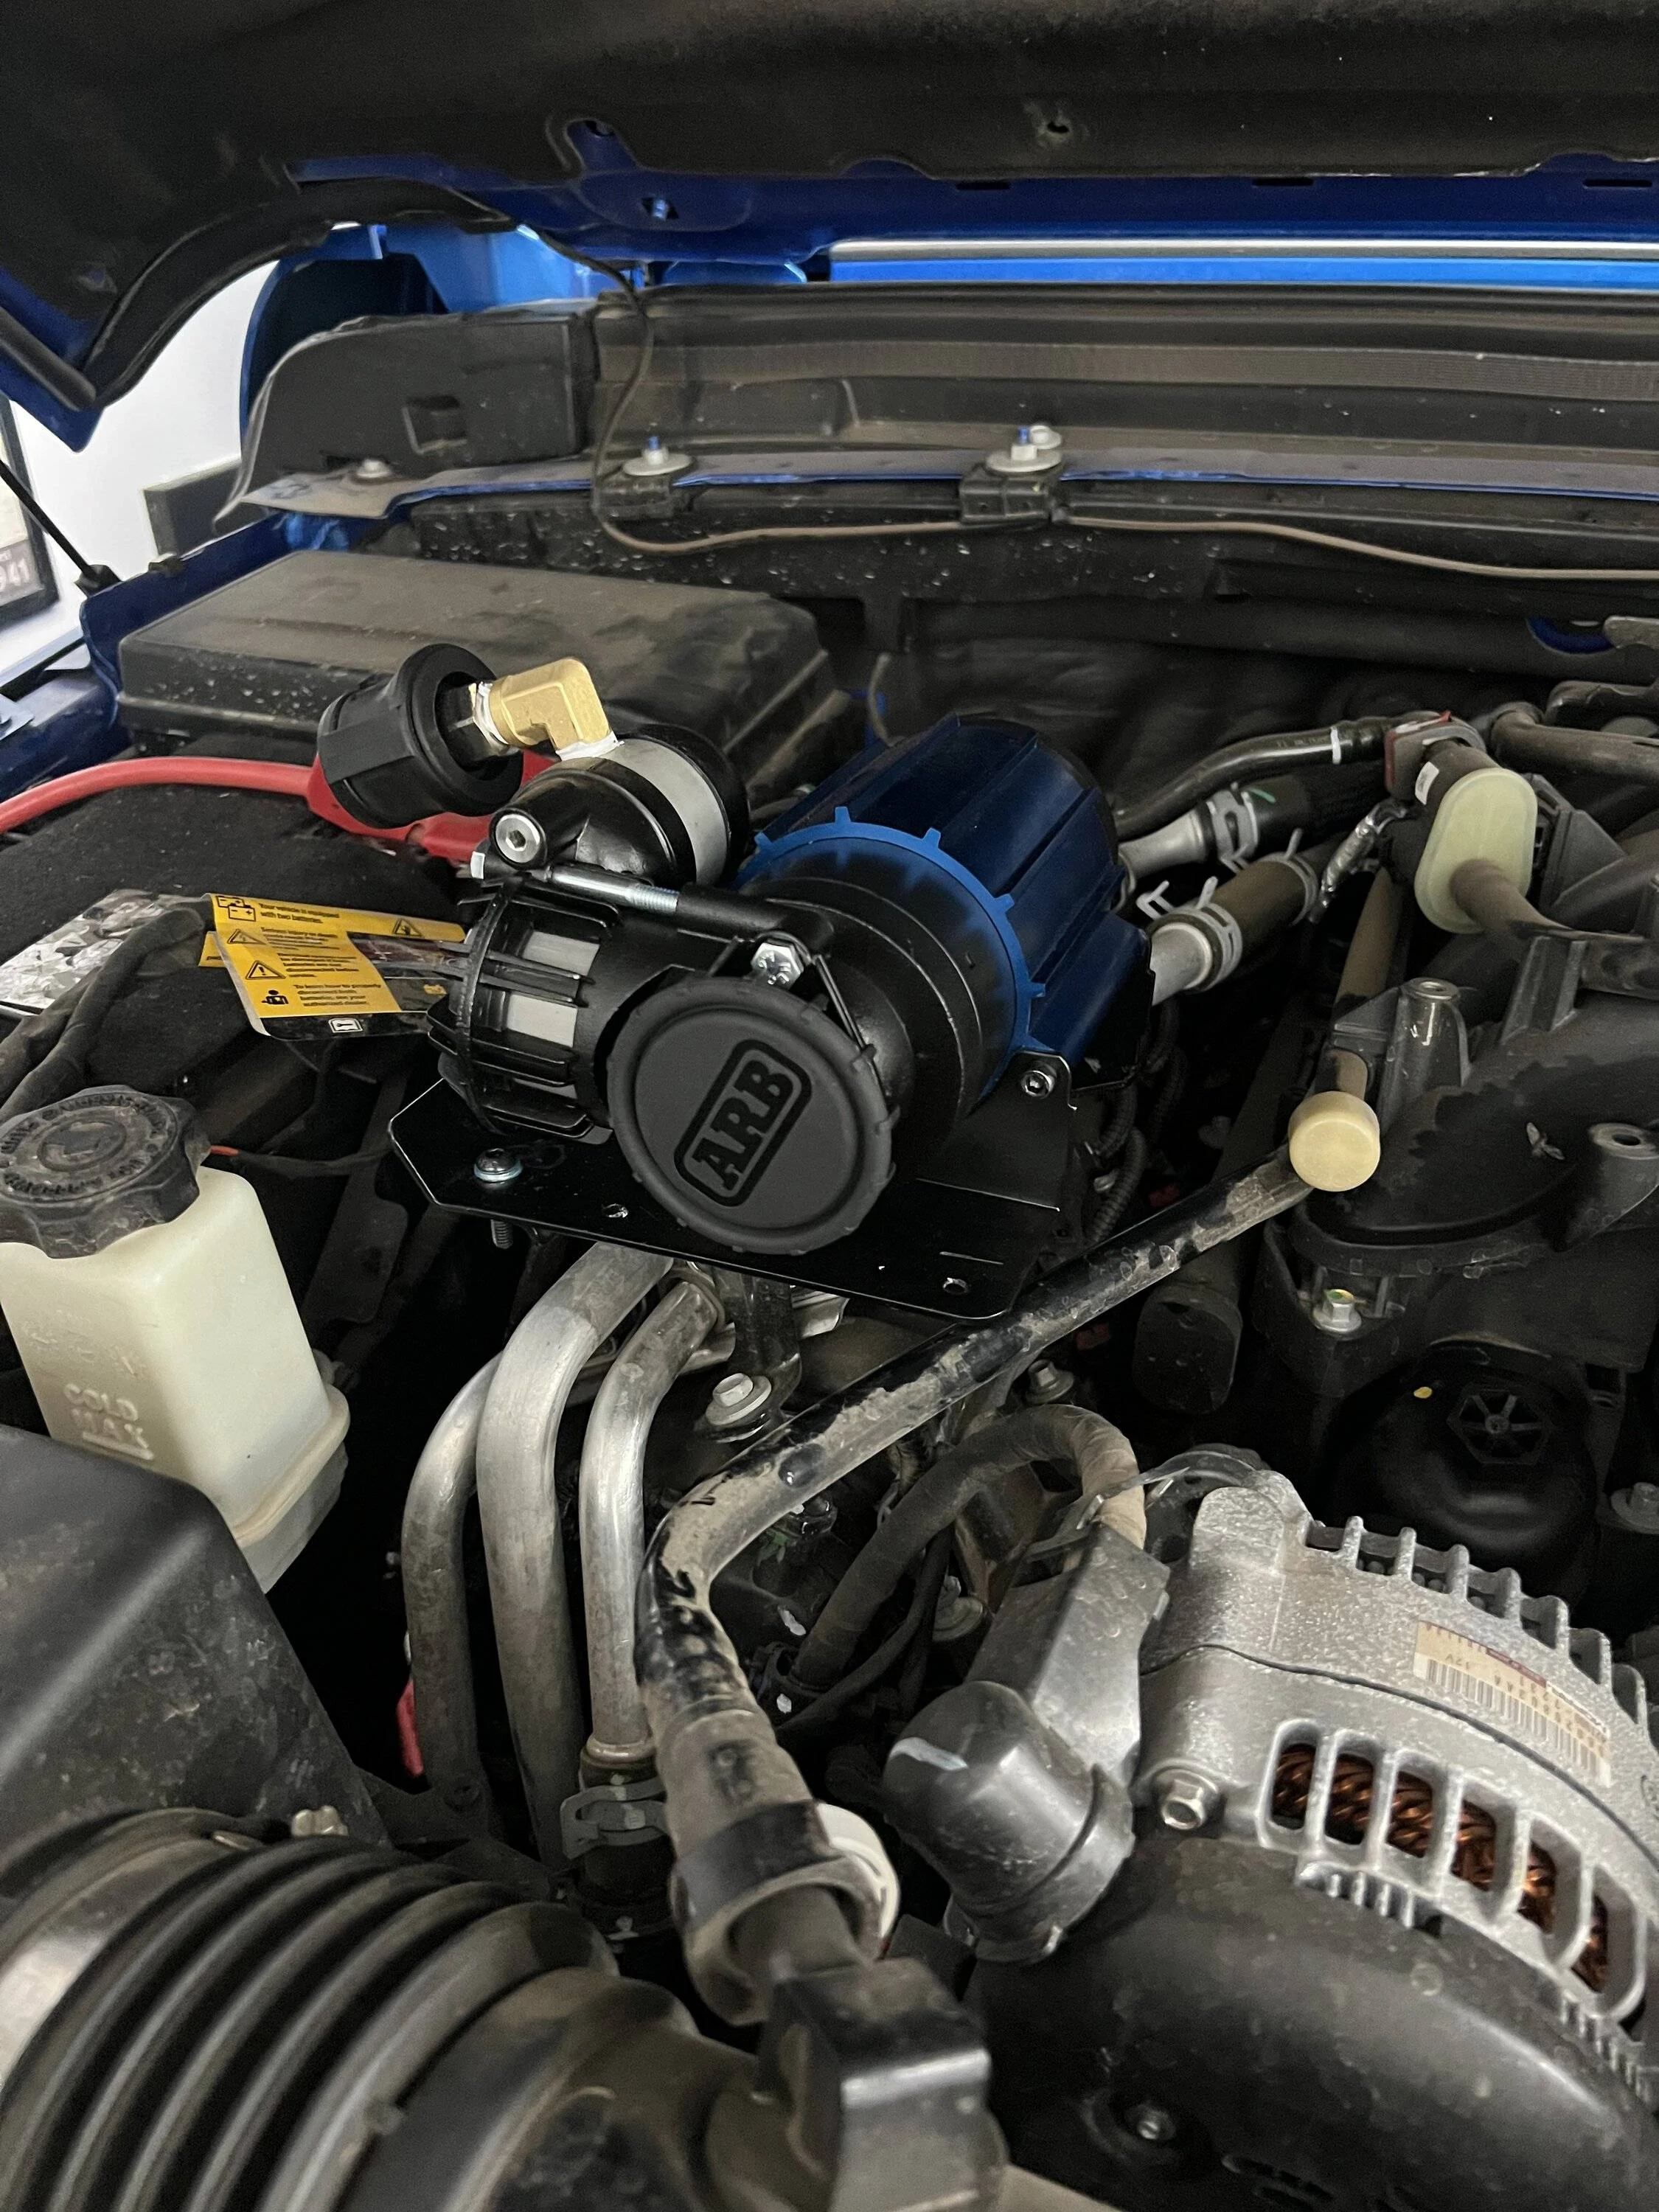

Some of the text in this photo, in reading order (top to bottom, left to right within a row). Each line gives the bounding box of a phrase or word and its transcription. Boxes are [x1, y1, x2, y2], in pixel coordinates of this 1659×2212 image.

[692, 1060, 794, 1191] ARB
[63, 1382, 139, 1422] COLD
[72, 1408, 149, 1450] MAX
